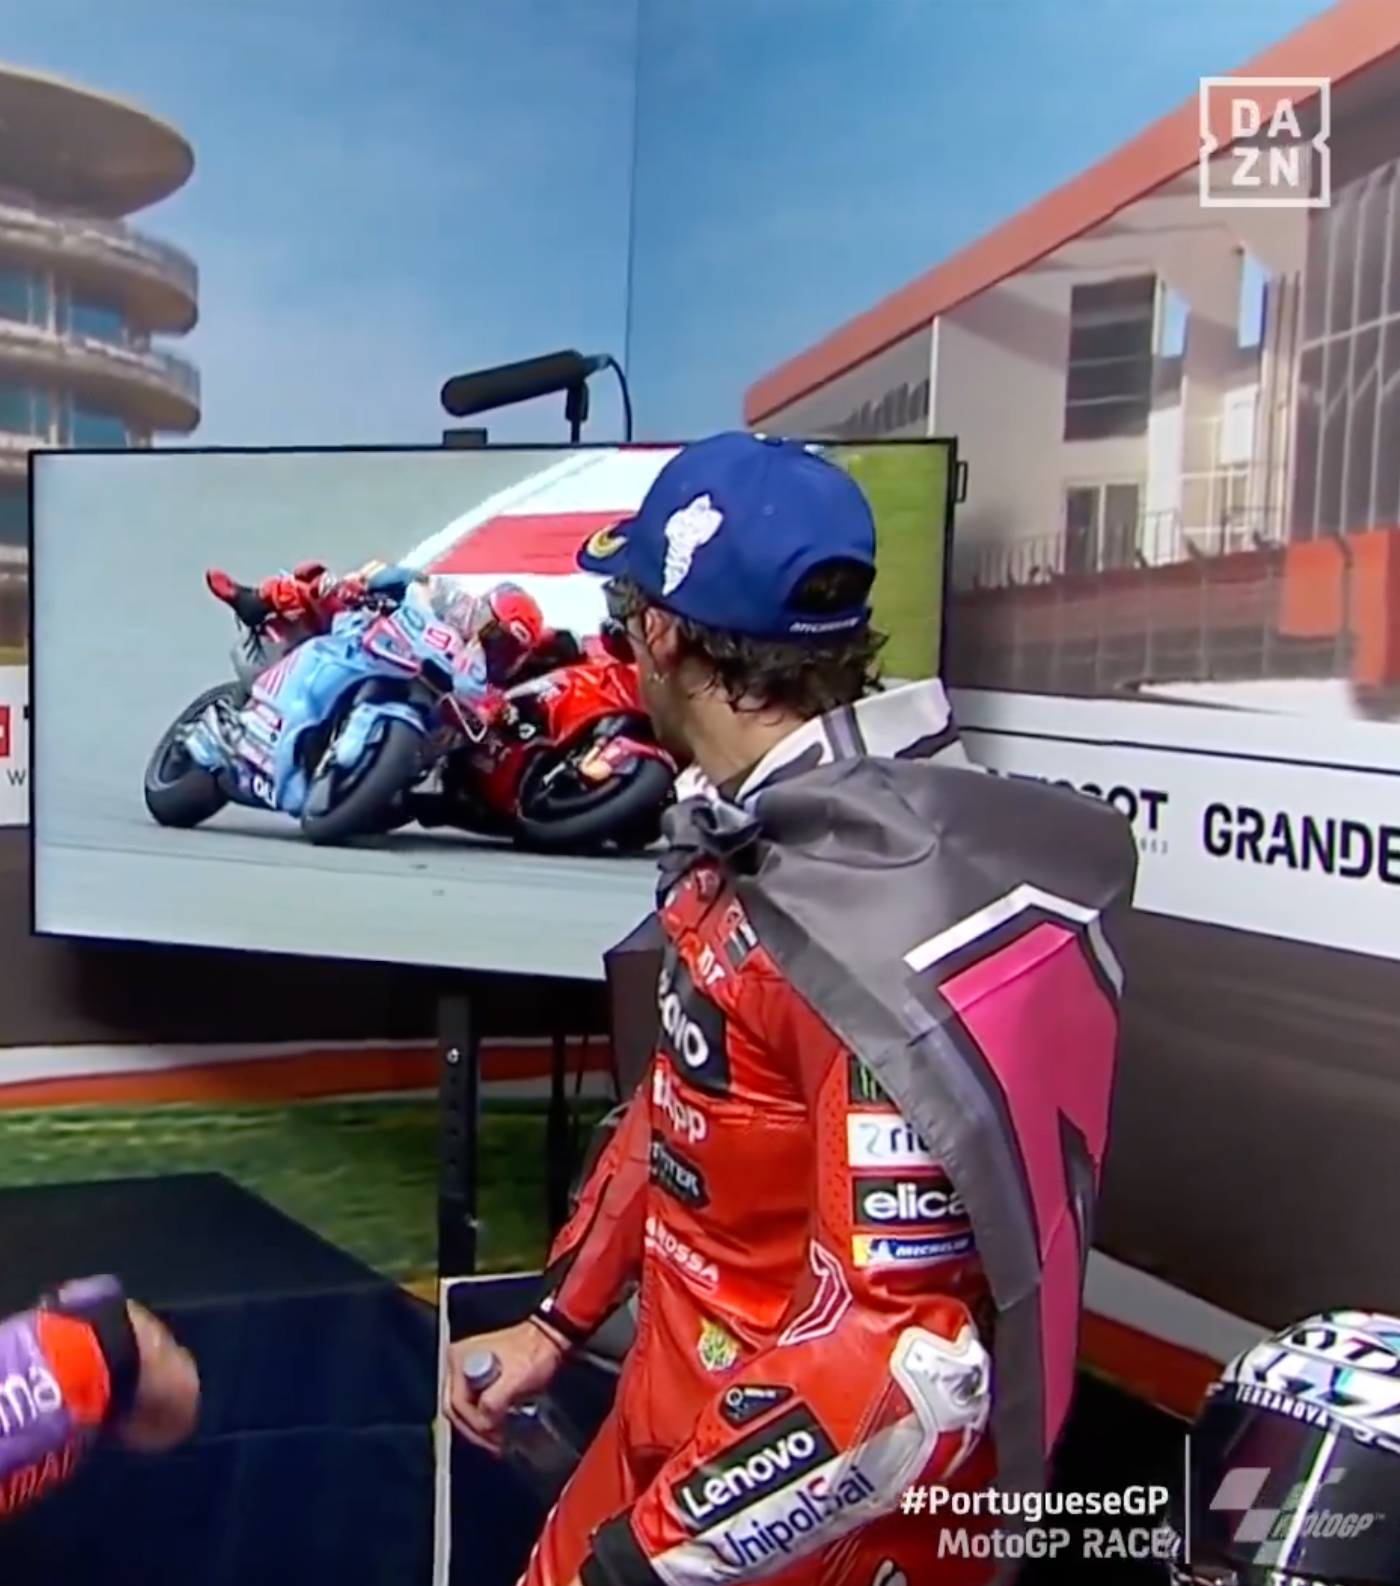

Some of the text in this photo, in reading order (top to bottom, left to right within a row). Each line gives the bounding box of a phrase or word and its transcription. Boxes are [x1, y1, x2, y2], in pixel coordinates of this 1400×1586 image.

[7, 767, 27, 787] W
[1203, 803, 1400, 885] GRANDE
[1234, 1382, 1329, 1428] TERRANOVA
[681, 1429, 816, 1519] Lenovo
[708, 1464, 876, 1569] UnipolSai
